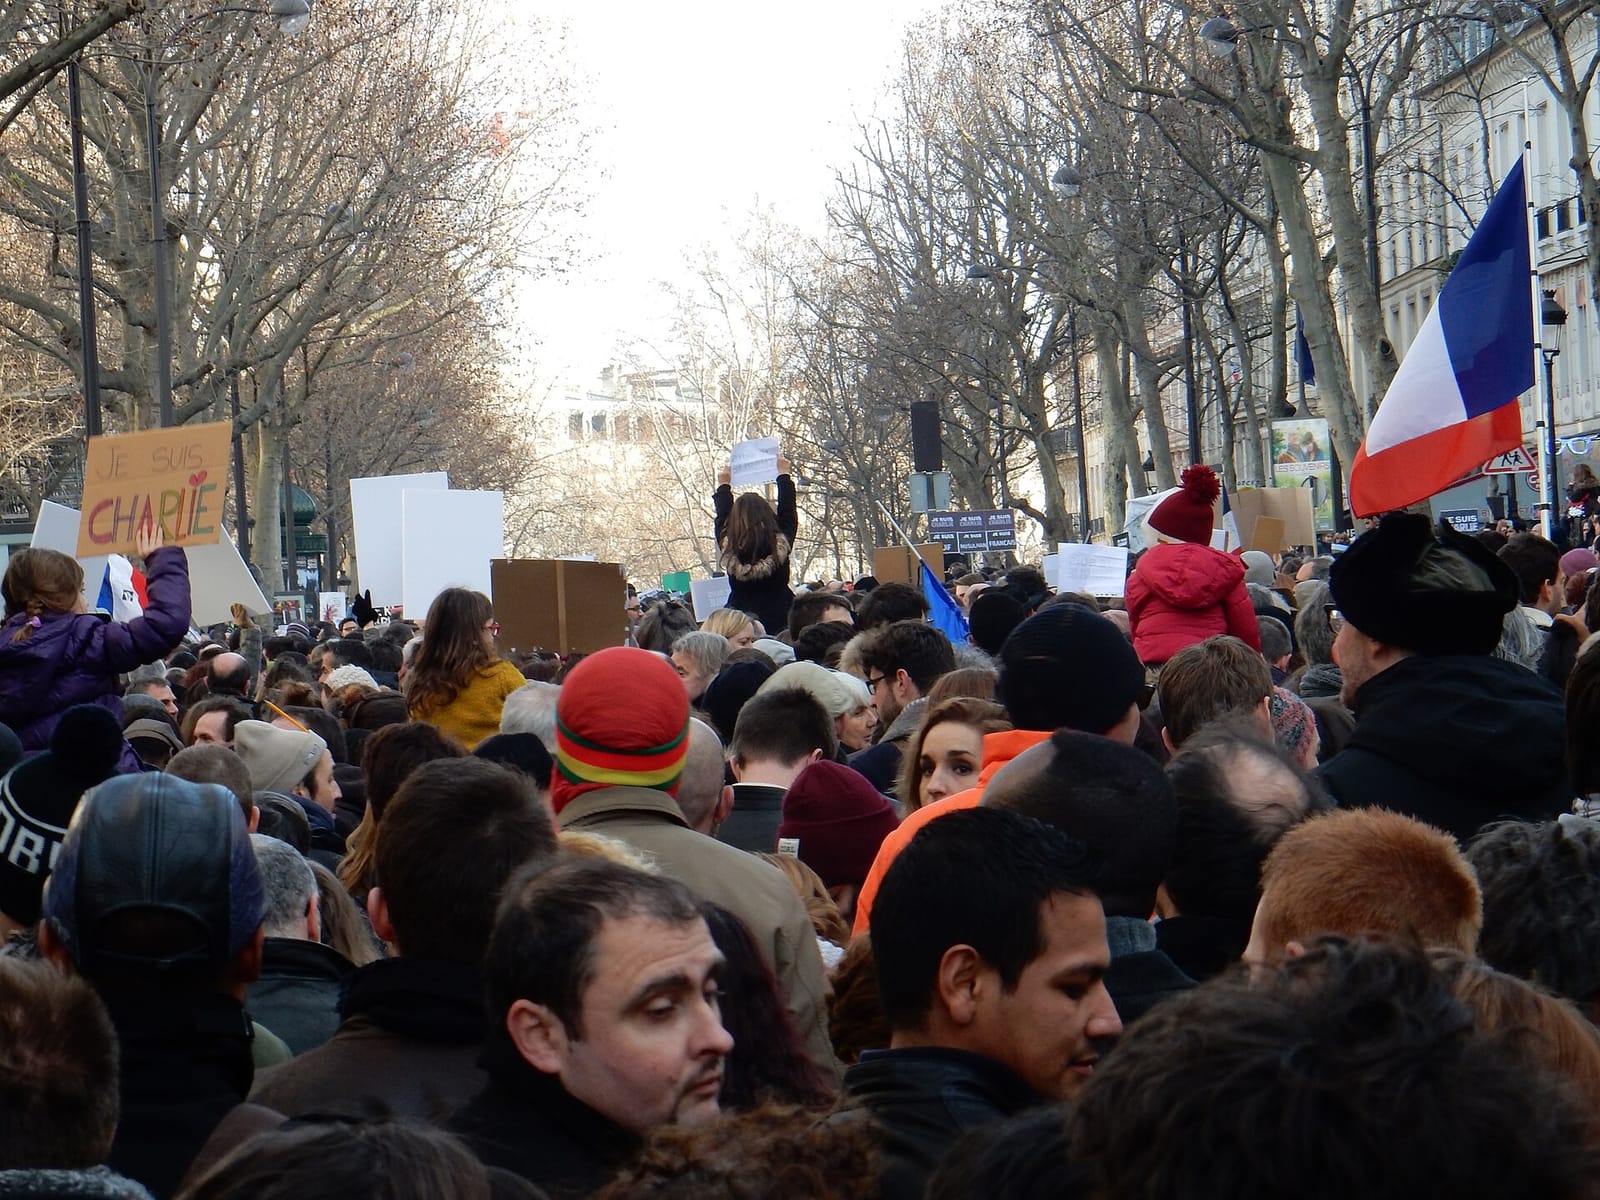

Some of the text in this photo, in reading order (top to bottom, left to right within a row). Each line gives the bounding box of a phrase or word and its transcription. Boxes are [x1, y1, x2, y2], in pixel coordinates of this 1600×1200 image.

[96, 443, 203, 480] JE SUIS
[88, 469, 217, 545] CHARLIE
[1455, 515, 1477, 523] SUIS
